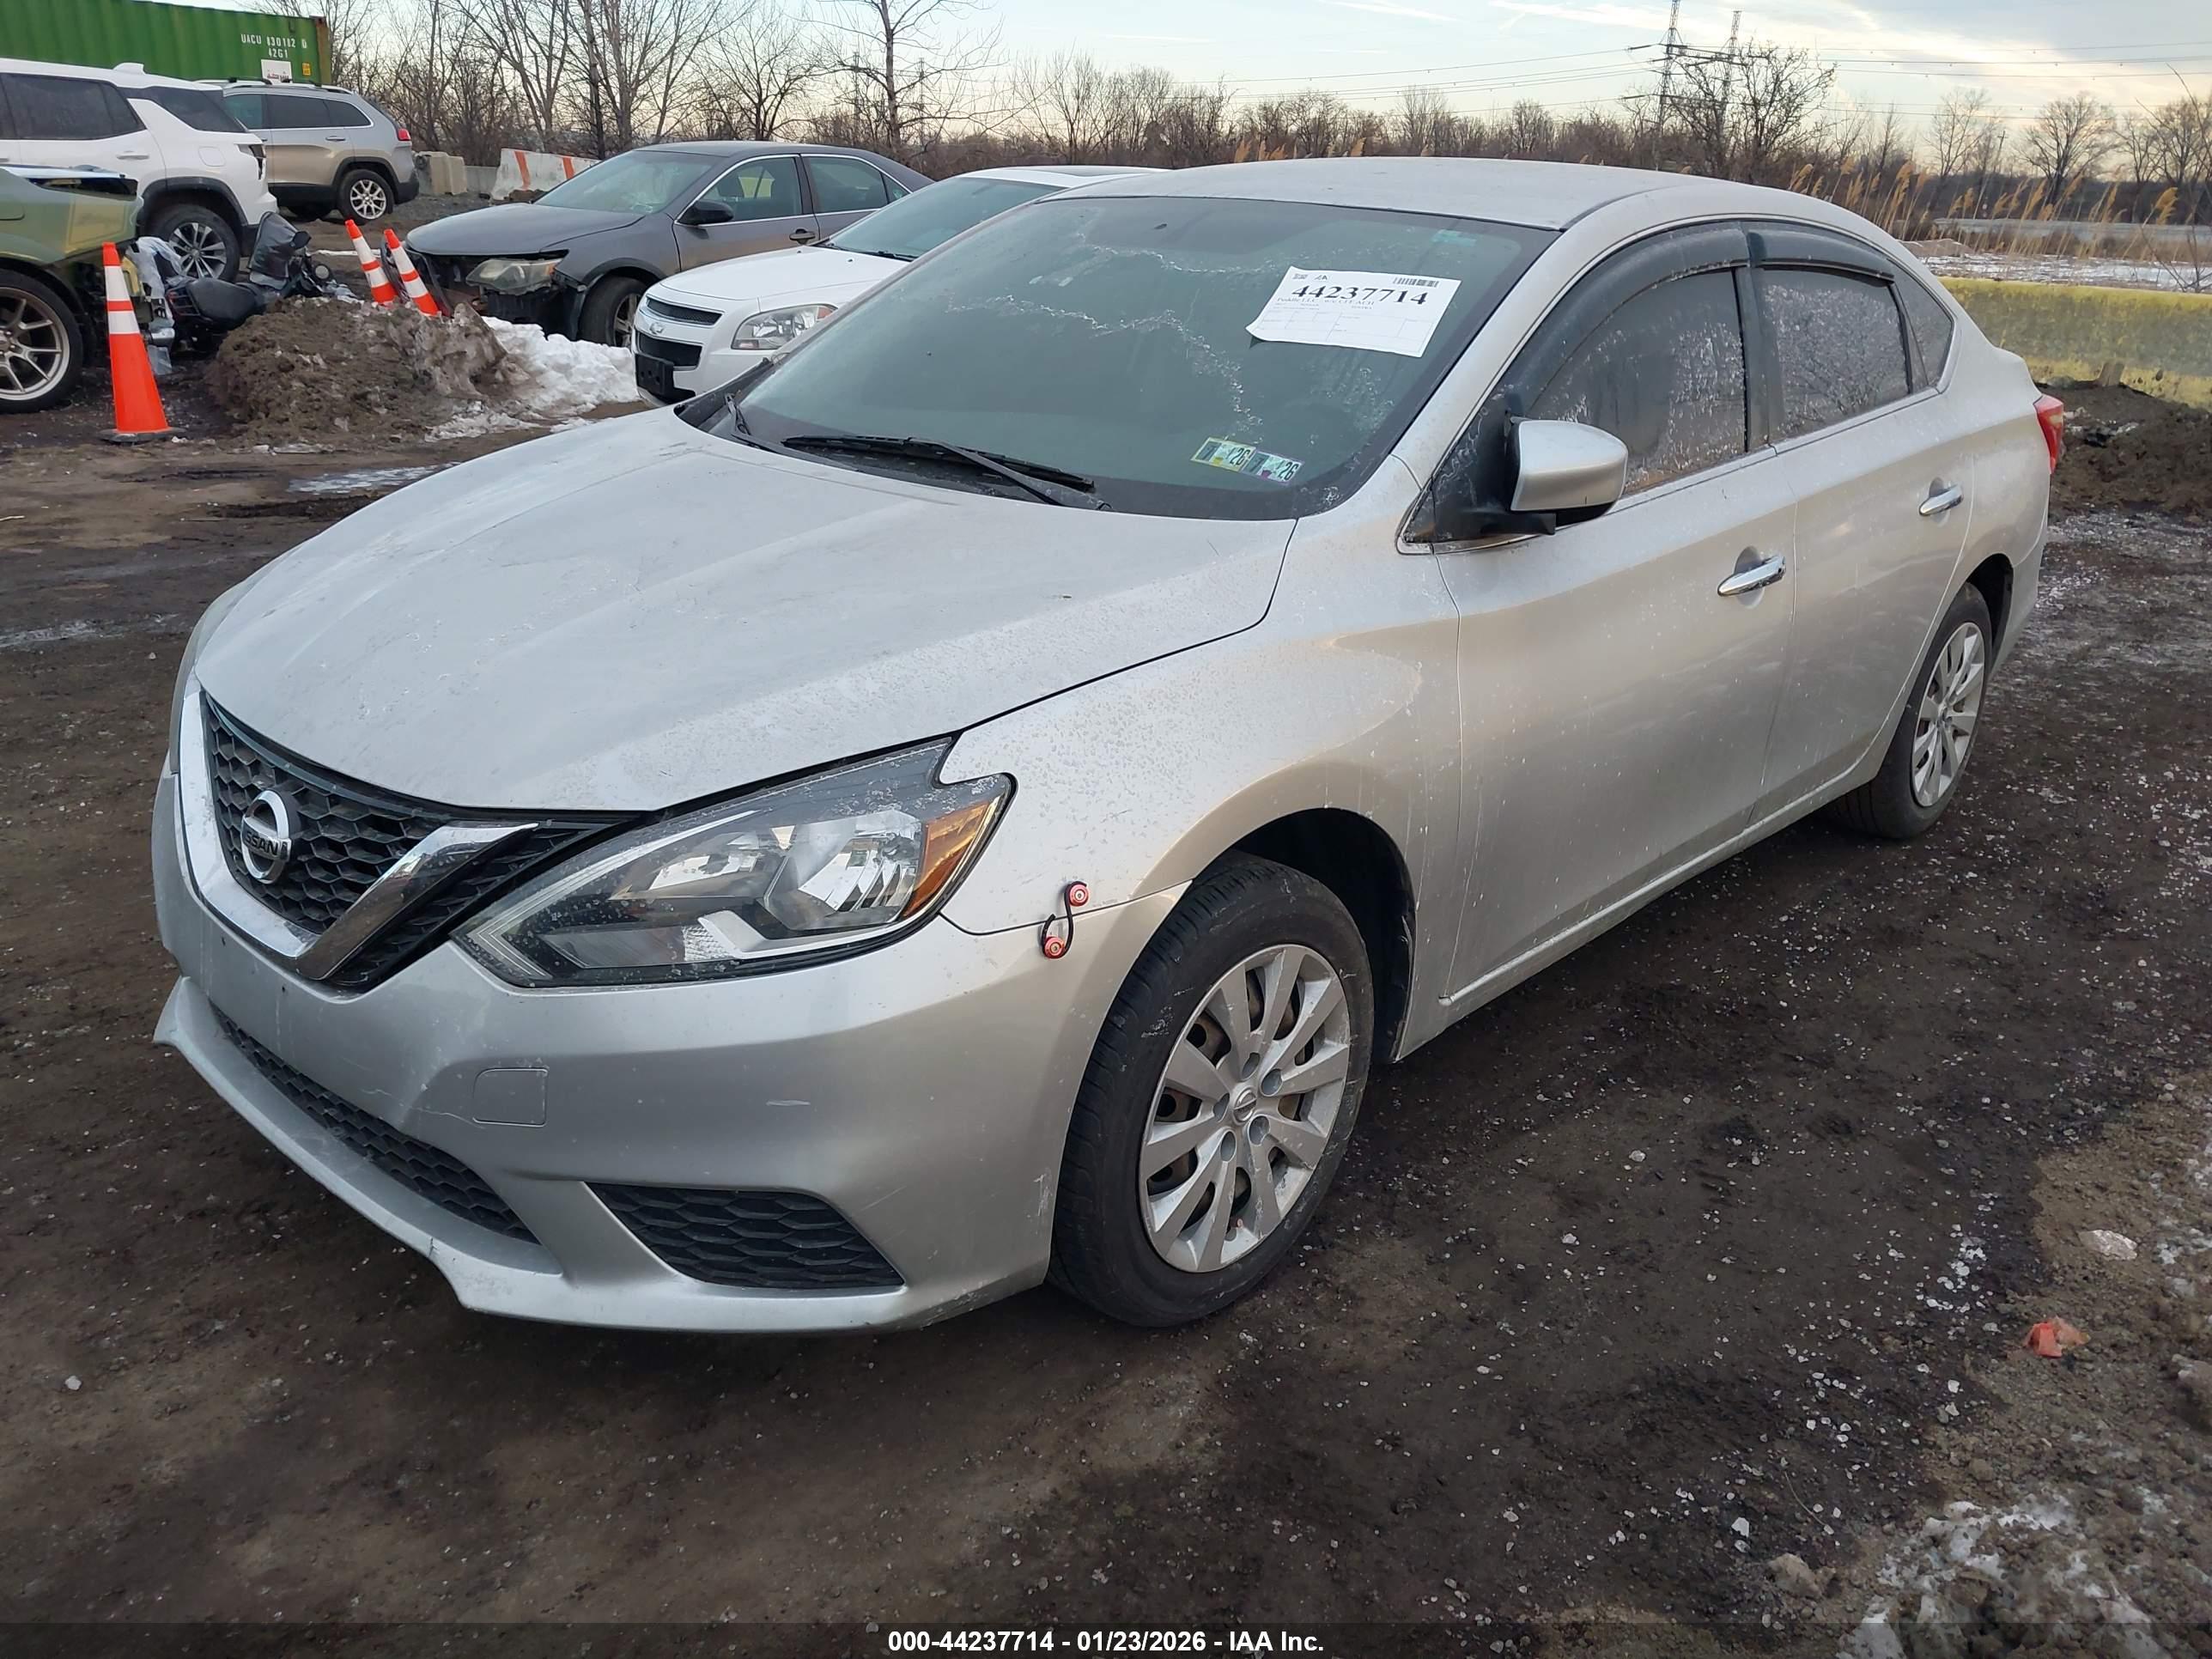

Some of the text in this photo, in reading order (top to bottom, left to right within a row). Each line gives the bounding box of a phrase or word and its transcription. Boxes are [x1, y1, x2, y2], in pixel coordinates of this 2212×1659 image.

[240, 33, 262, 45] UACU
[268, 47, 289, 58] 42G1
[1291, 285, 1429, 306] 44237714
